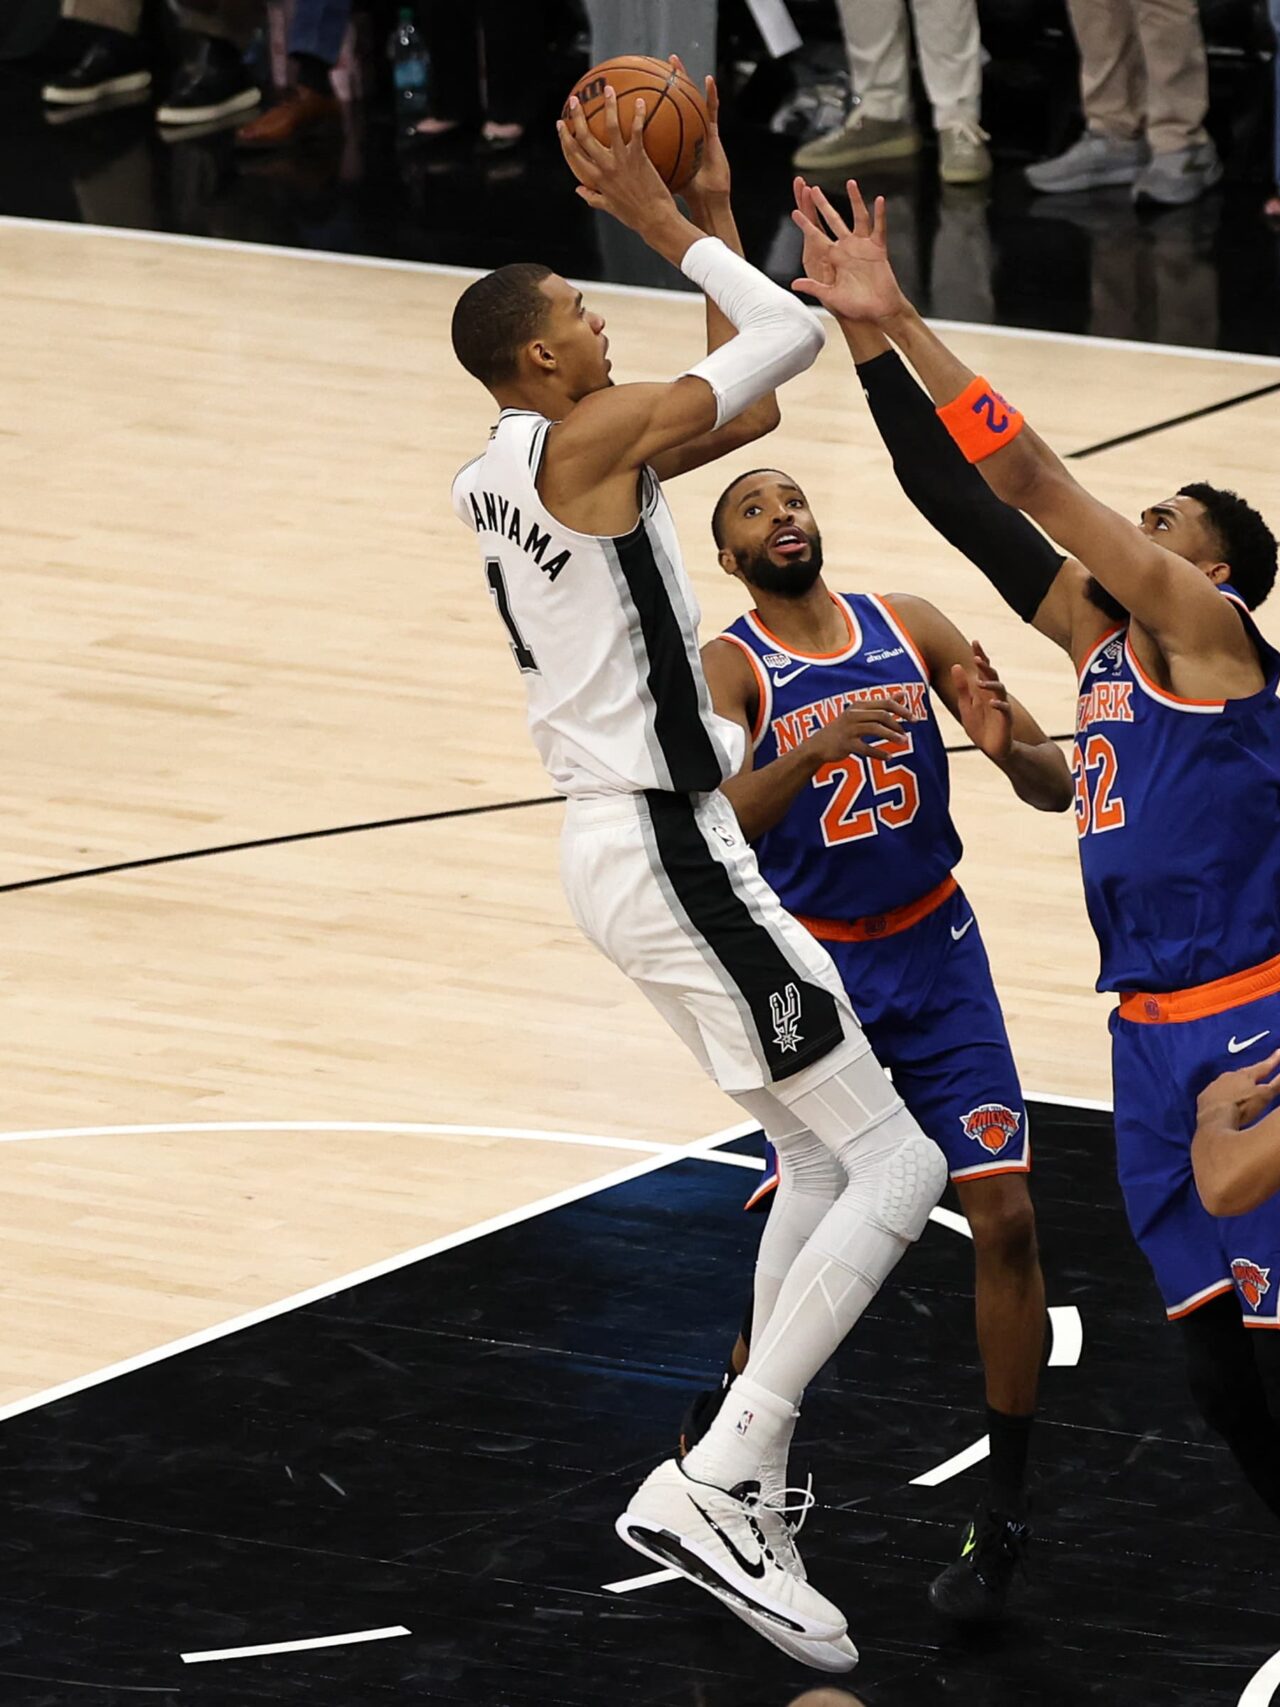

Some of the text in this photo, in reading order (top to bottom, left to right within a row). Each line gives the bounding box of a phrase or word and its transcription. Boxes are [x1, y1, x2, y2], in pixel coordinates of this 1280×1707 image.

[470, 491, 571, 582] ANYAMA
[485, 556, 541, 674] 1
[812, 732, 921, 847] 25
